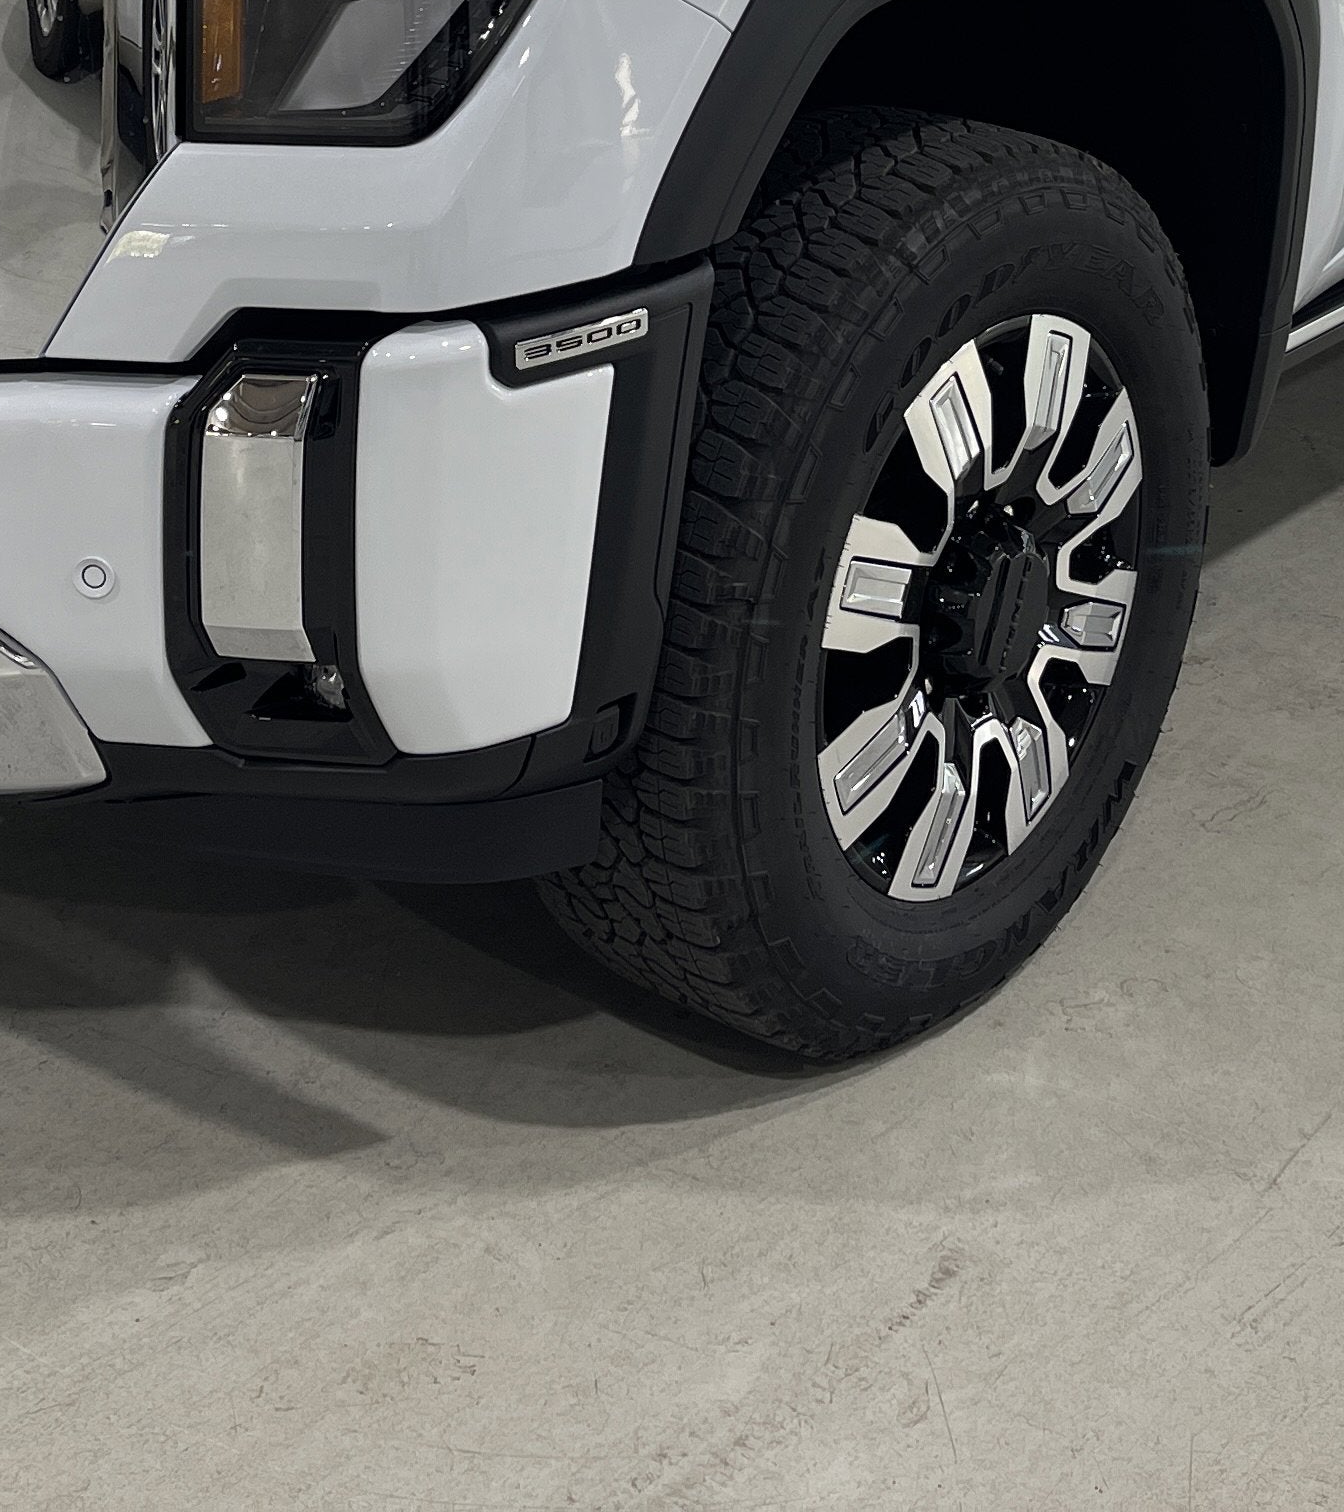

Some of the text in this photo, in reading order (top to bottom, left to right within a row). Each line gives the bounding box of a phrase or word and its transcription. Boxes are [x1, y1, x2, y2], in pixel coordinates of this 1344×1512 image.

[524, 318, 642, 360] 3500
[862, 240, 1166, 454] GOODYEAR
[845, 758, 1138, 988] WRANGLER
